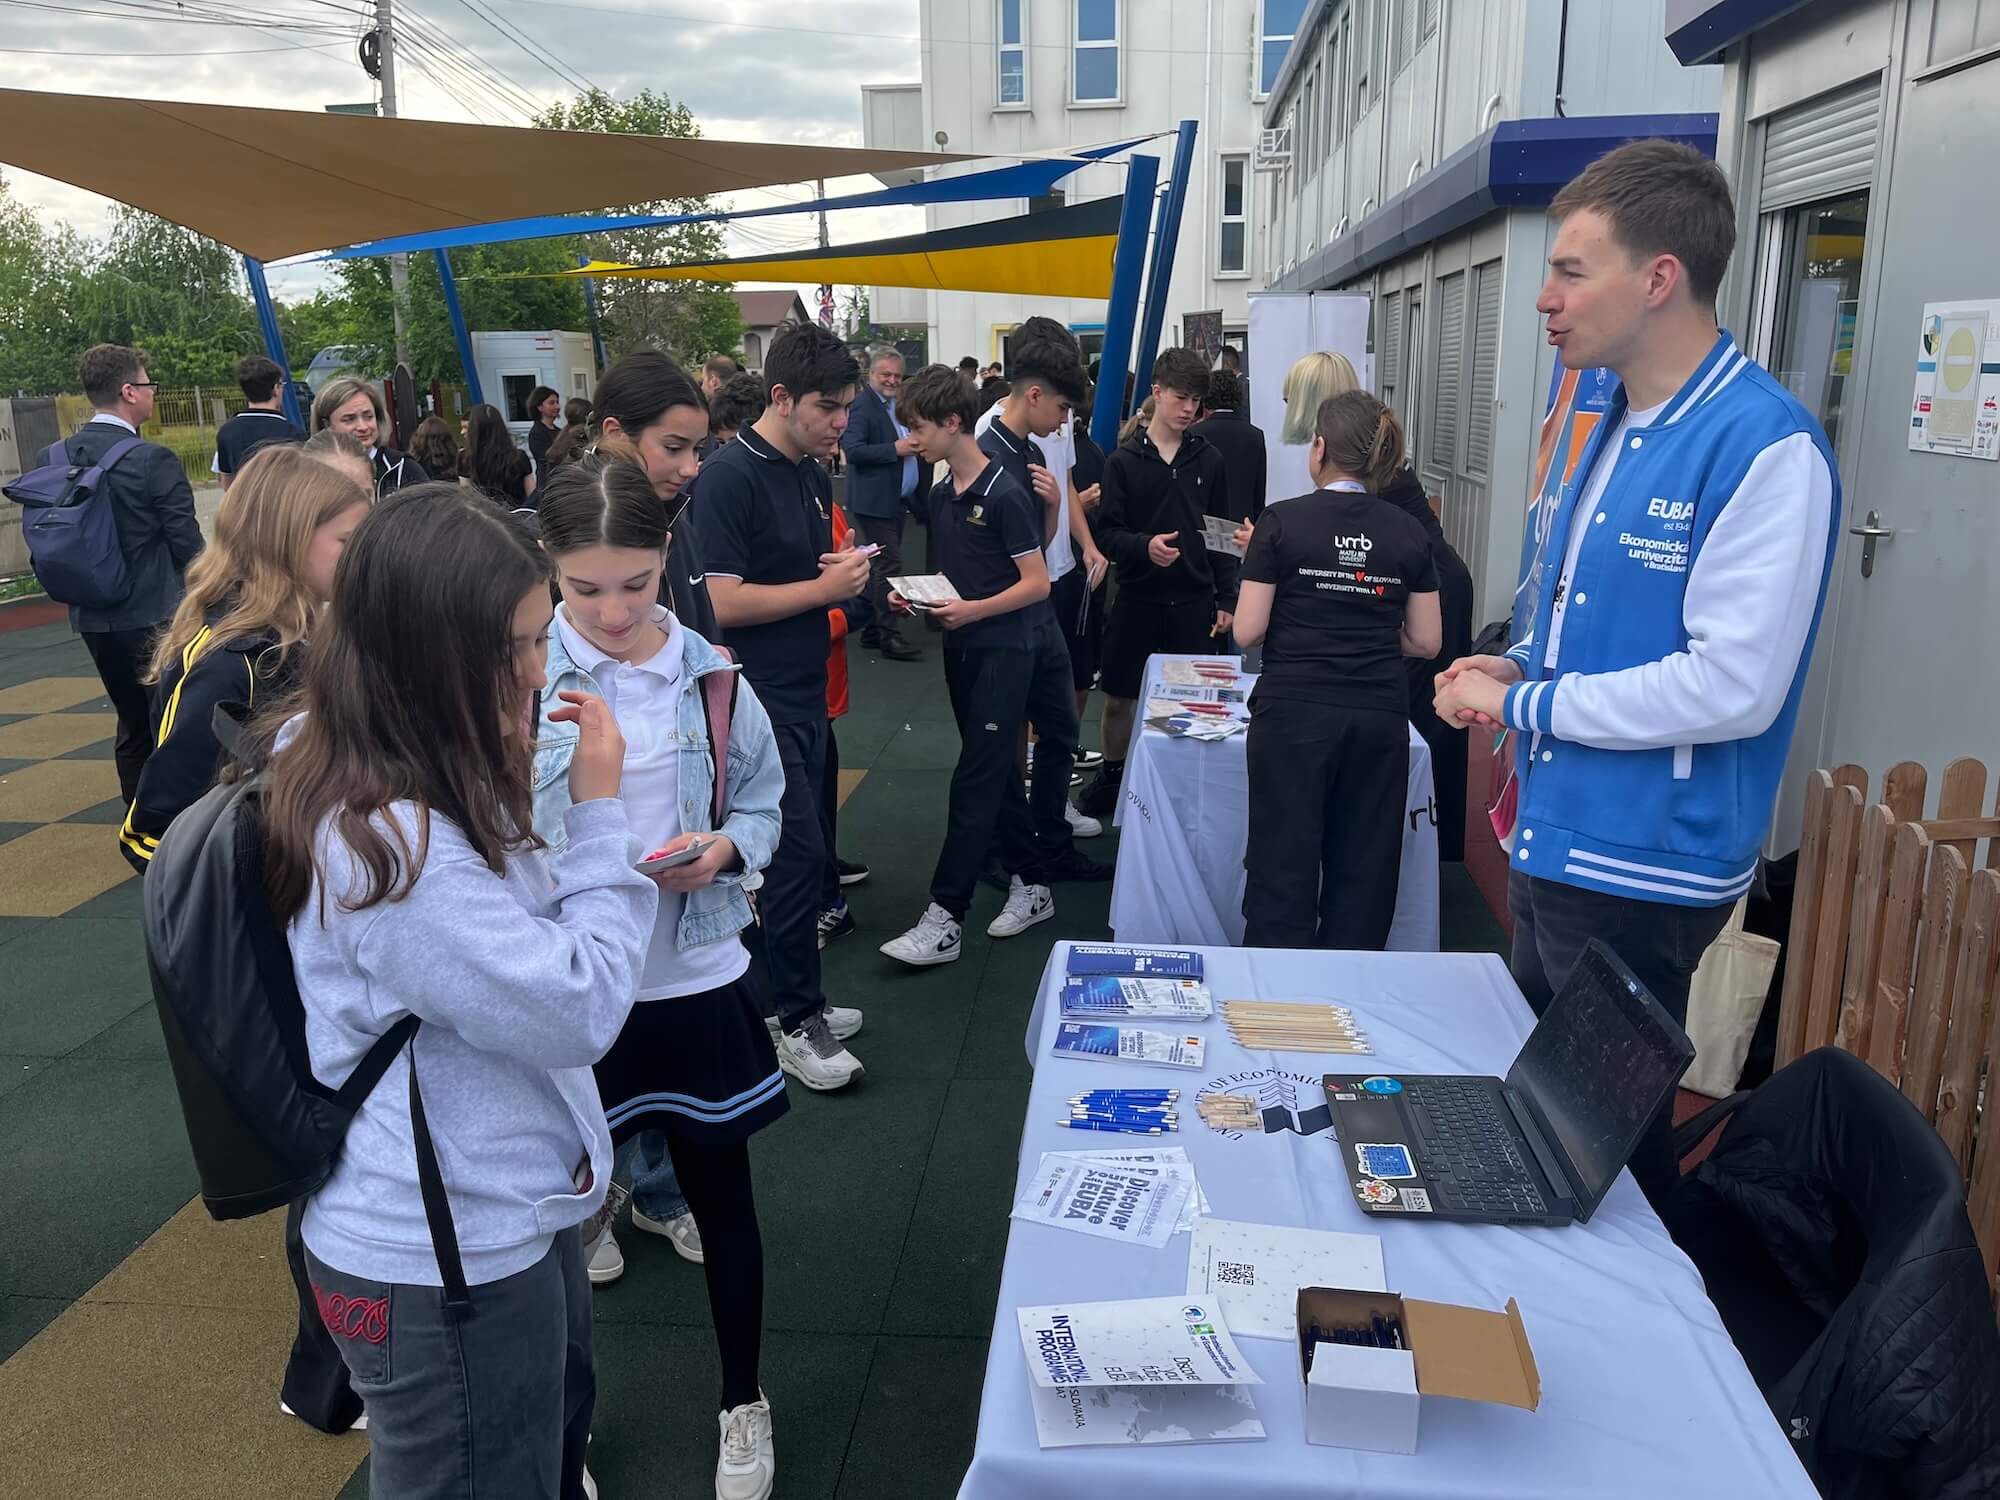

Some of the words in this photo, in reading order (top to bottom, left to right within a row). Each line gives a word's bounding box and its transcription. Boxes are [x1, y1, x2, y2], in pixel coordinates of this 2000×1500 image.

[1647, 497, 1695, 521] EUBA
[1334, 532, 1373, 551] umb
[1628, 548, 1687, 565] univerzita
[1299, 567, 1337, 579] UNIVERSITY
[1316, 582, 1355, 593] UNIVERSITY
[1087, 1169, 1128, 1182] your
[1063, 1180, 1102, 1219] EUBA
[1087, 1180, 1125, 1225] future
[1110, 1177, 1150, 1231] Discover
[1036, 1329, 1080, 1384] PROGRAMMES
[1051, 1315, 1093, 1381] INTERNATIONAL
